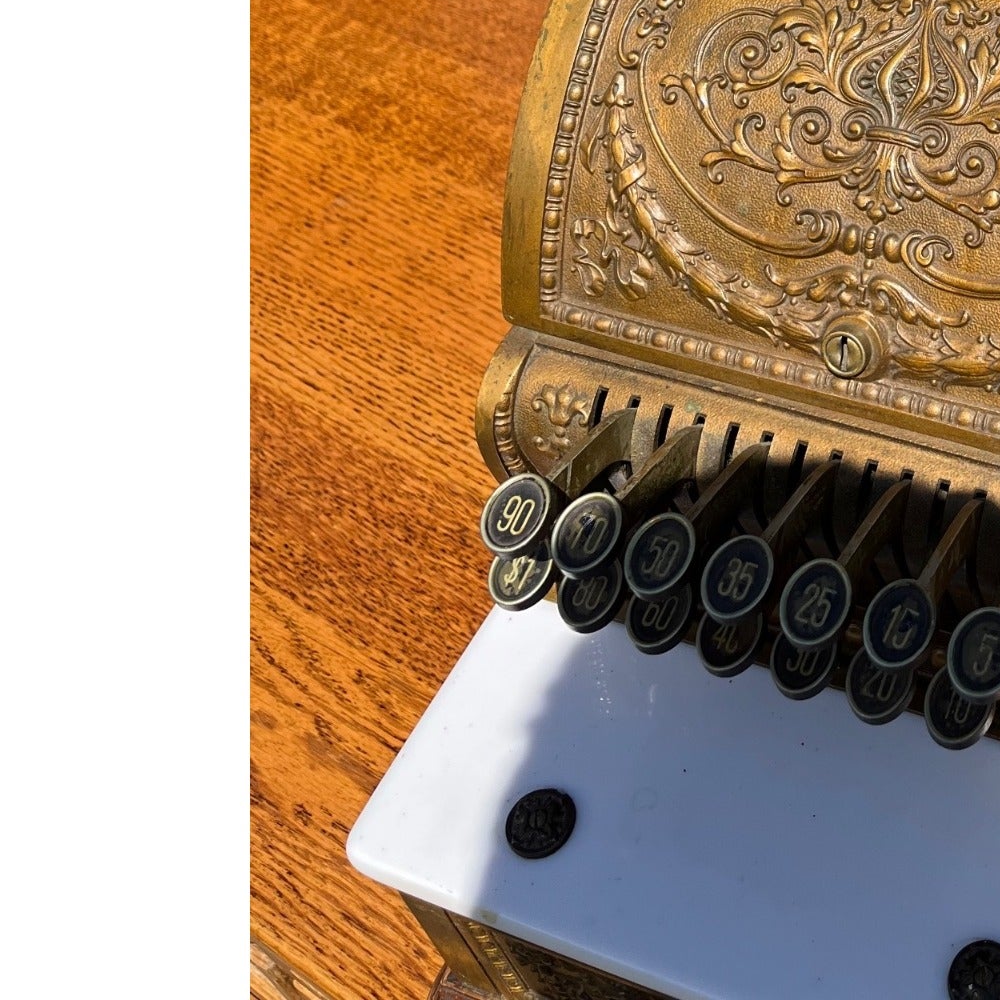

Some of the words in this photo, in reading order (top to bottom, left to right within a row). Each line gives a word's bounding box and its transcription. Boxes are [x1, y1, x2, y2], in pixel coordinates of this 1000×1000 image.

[496, 495, 536, 536] 90
[570, 512, 608, 555] 70
[504, 555, 534, 595] $1
[641, 535, 681, 578] 50
[571, 574, 608, 611] 80
[717, 557, 759, 602] 35
[641, 594, 679, 631] 60
[794, 582, 838, 629] 25
[882, 604, 920, 650] 15
[972, 632, 1000, 676] 5
